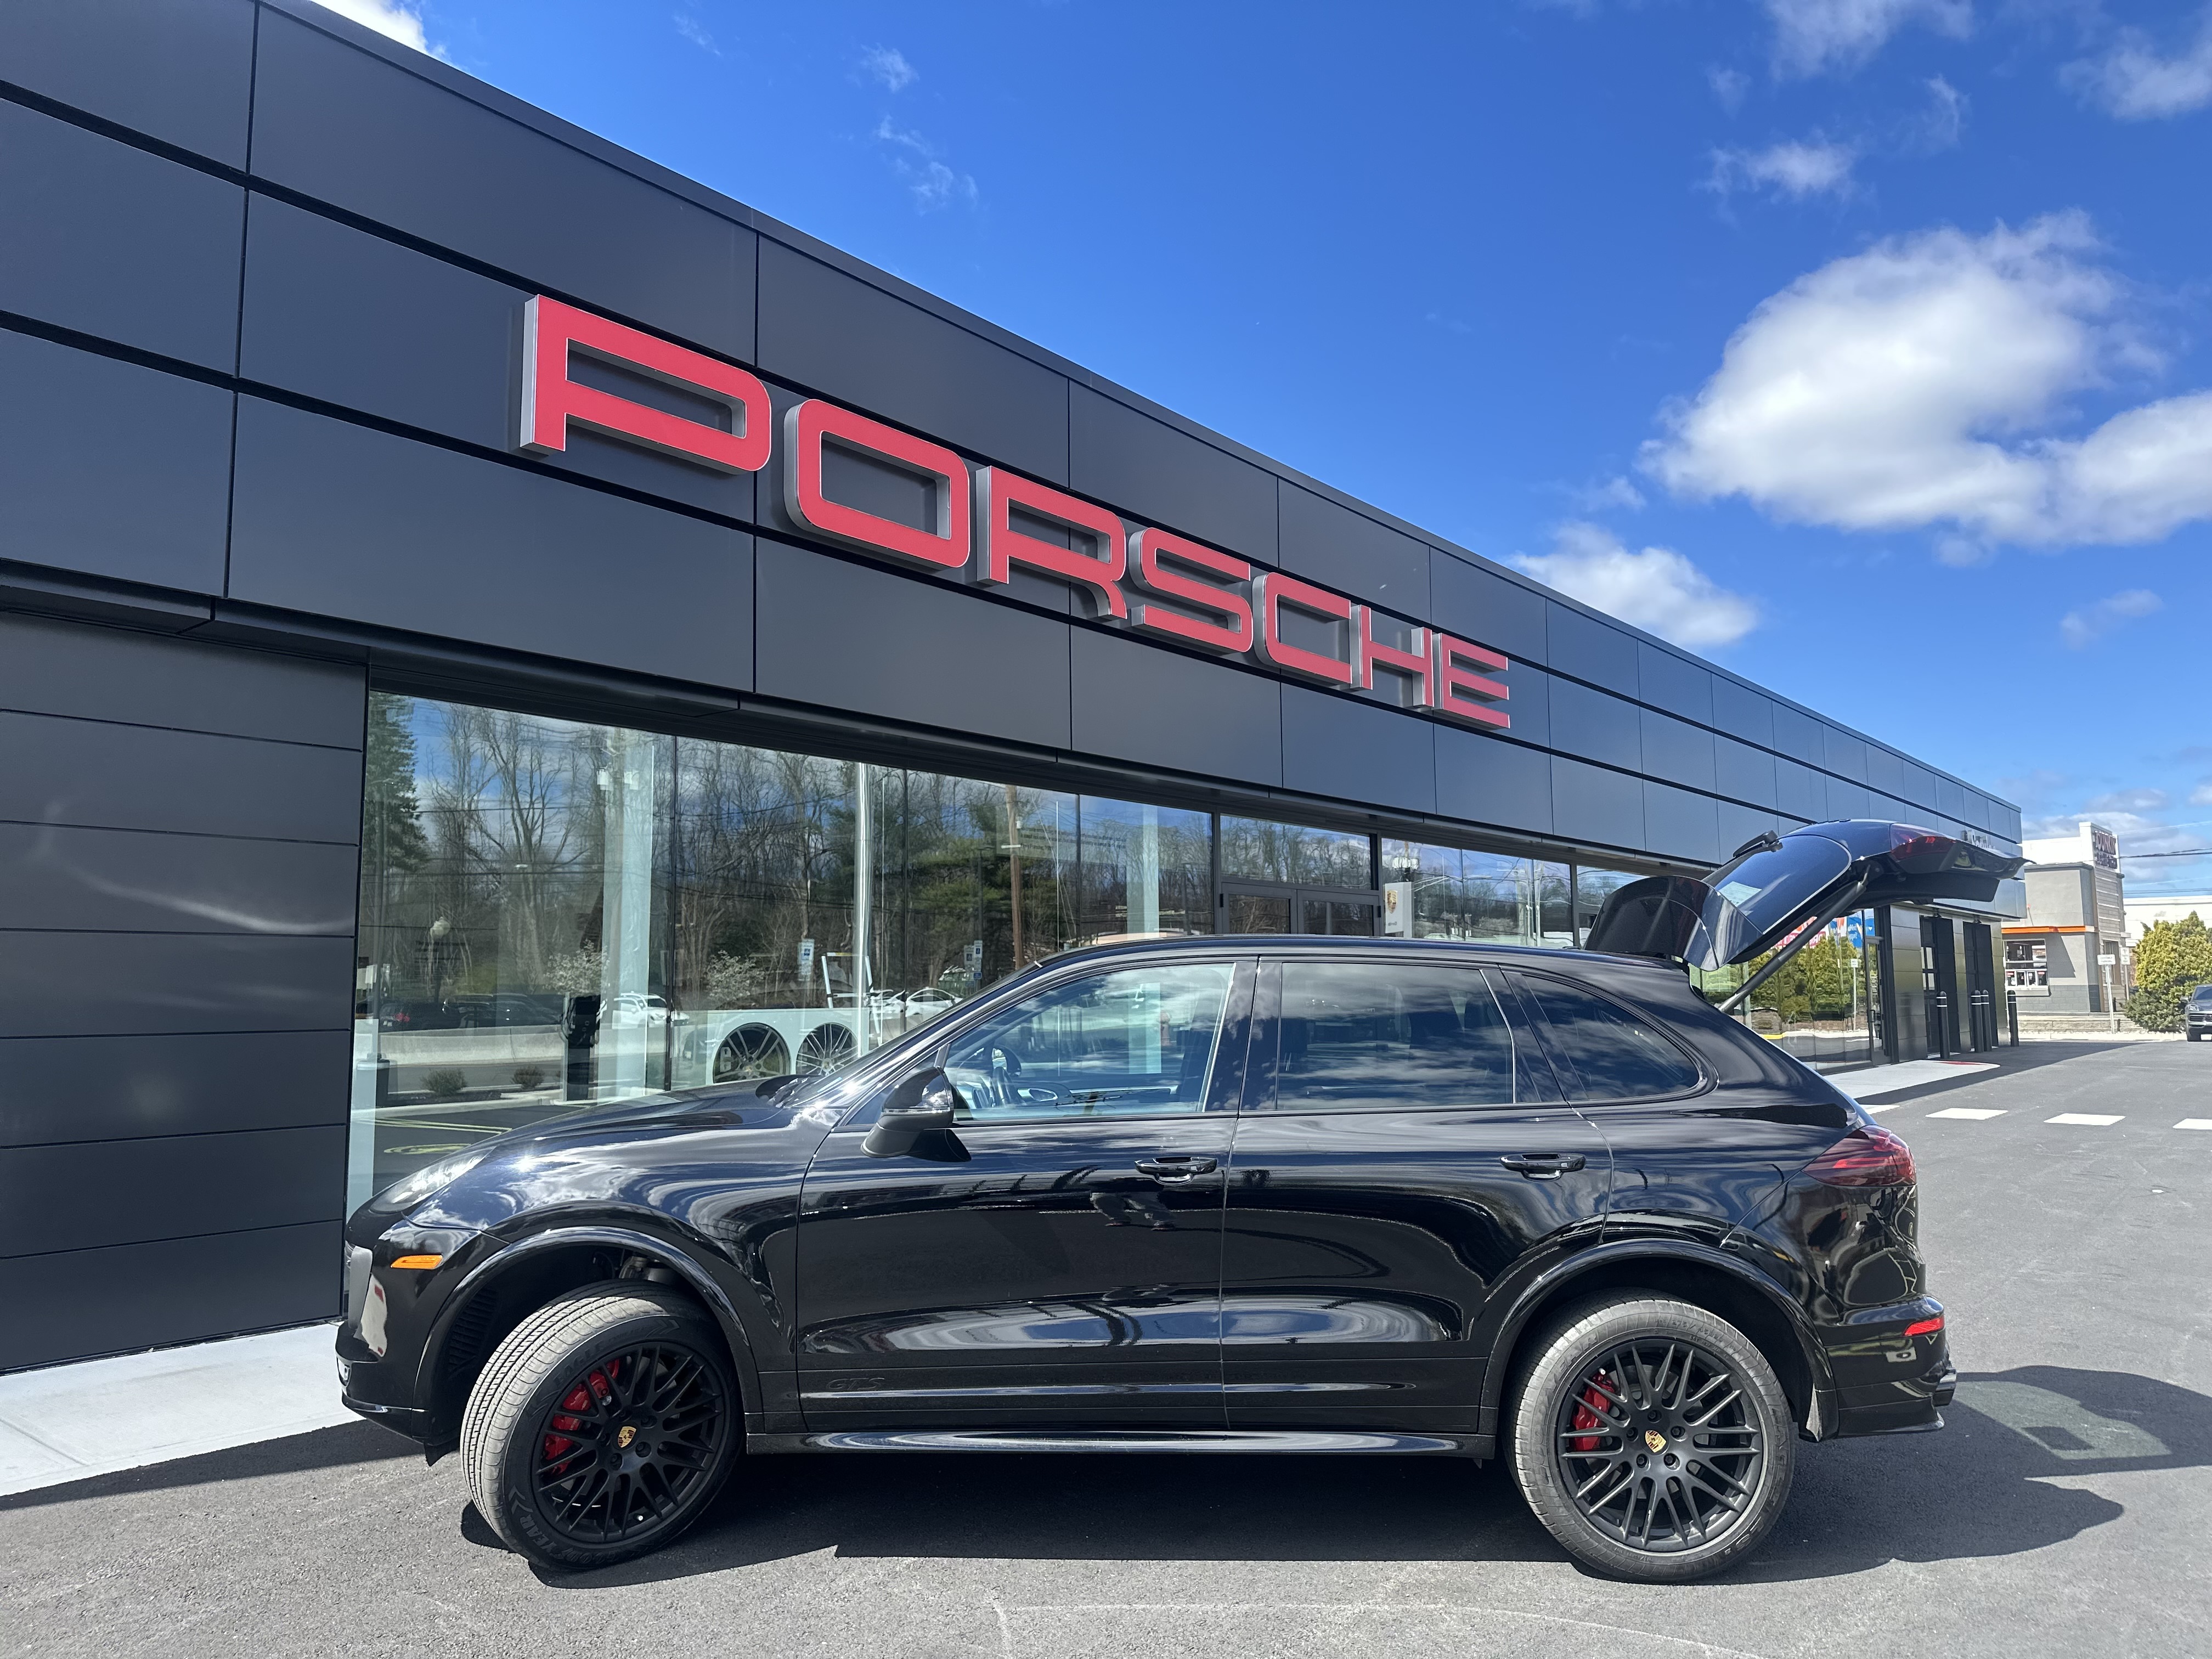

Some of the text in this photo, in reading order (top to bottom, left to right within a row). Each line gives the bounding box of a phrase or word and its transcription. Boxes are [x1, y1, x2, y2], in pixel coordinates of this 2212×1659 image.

[524, 294, 1510, 729] PORSCHE
[553, 1340, 608, 1387] EAGLE
[826, 1377, 885, 1391] GTS
